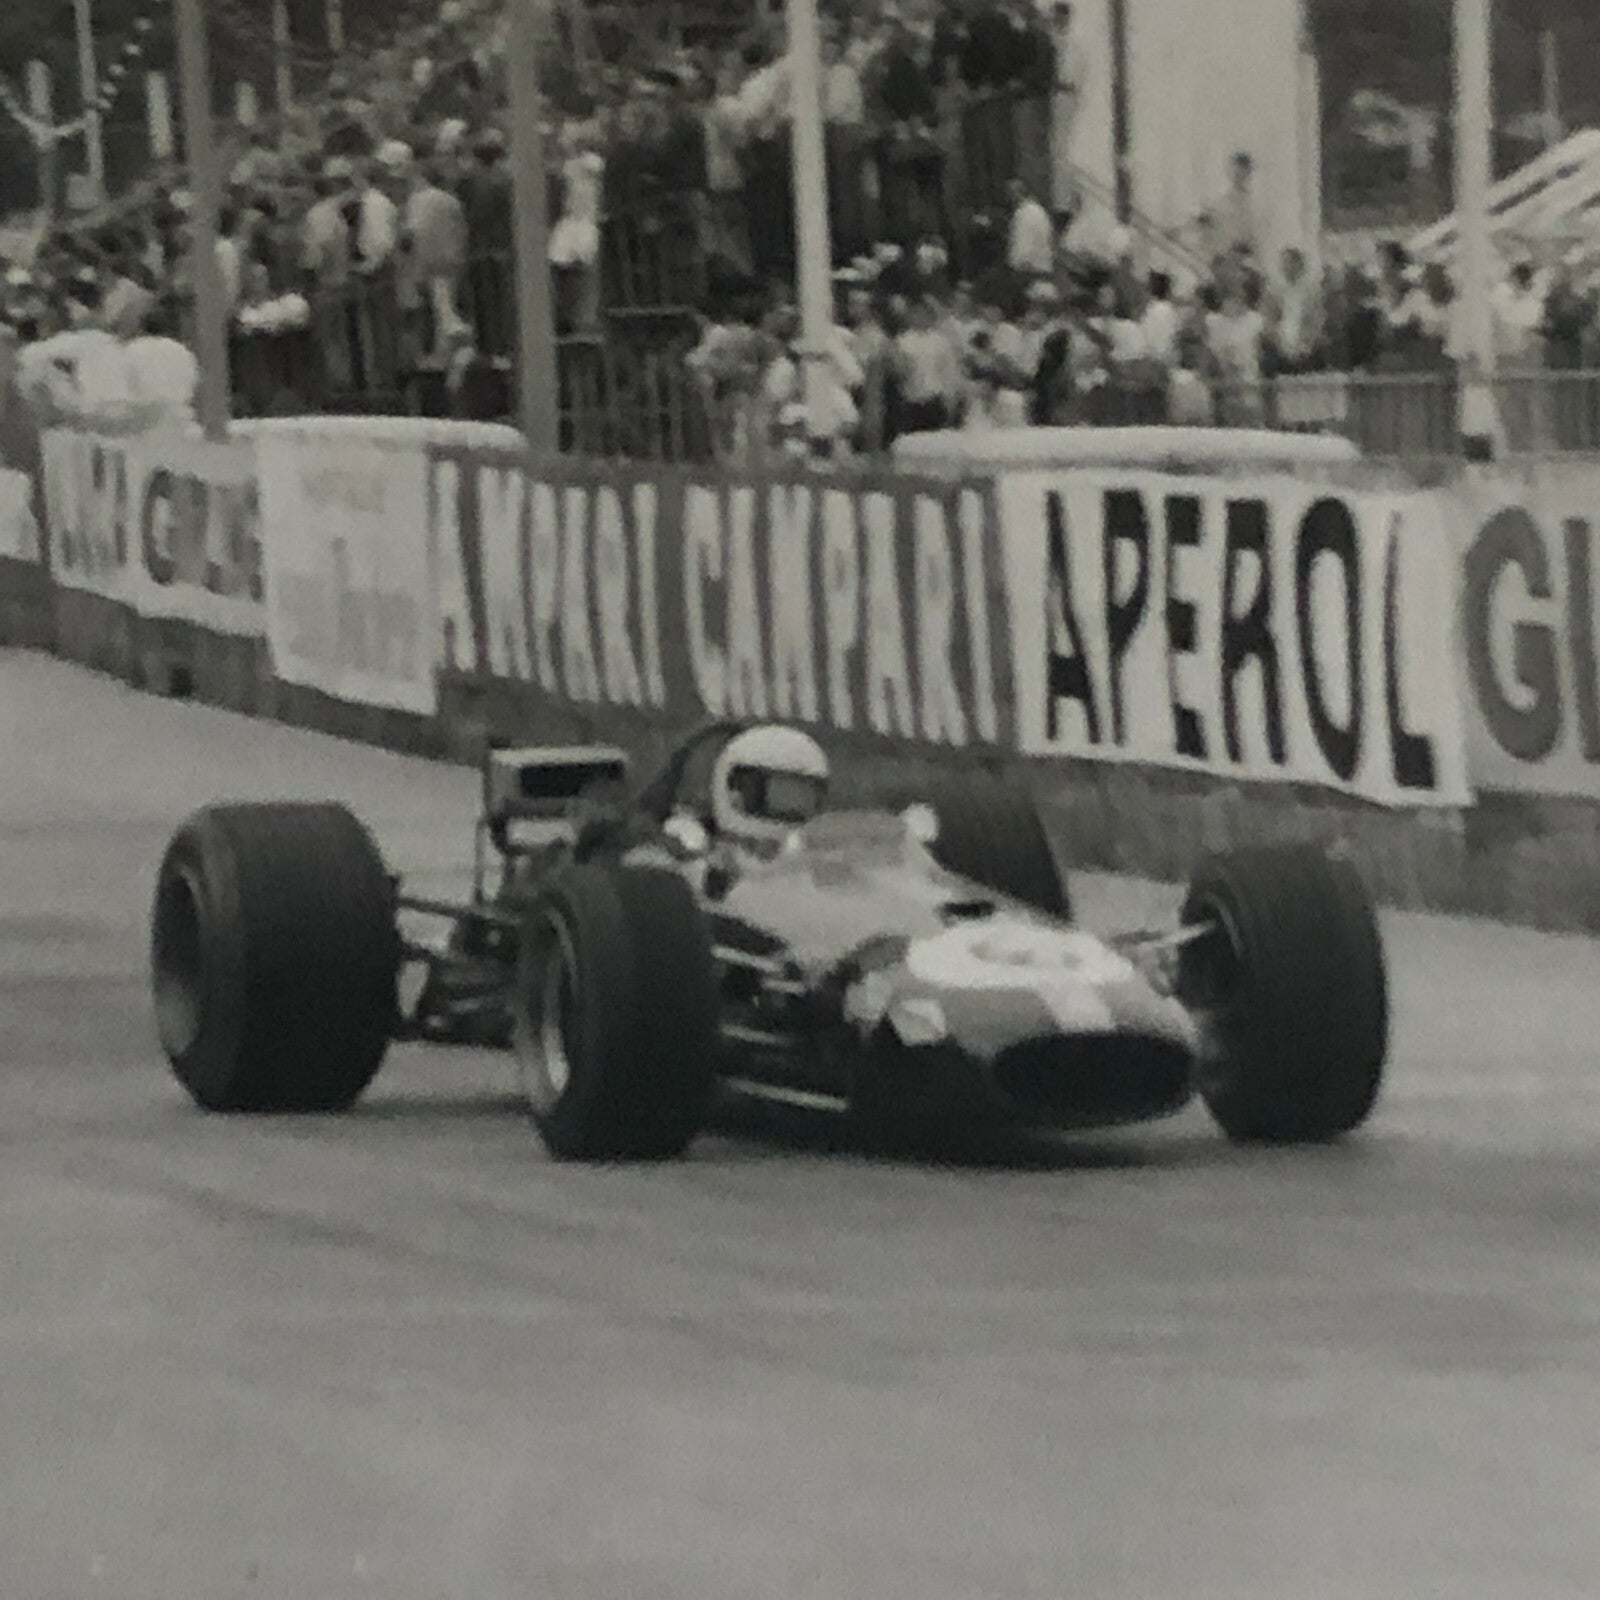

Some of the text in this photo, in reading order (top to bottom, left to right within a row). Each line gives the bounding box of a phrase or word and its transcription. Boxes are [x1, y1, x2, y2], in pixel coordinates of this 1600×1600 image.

[436, 460, 664, 709] AMPARI
[684, 484, 997, 746] CAMPARI
[1045, 488, 1435, 789] APEROL
